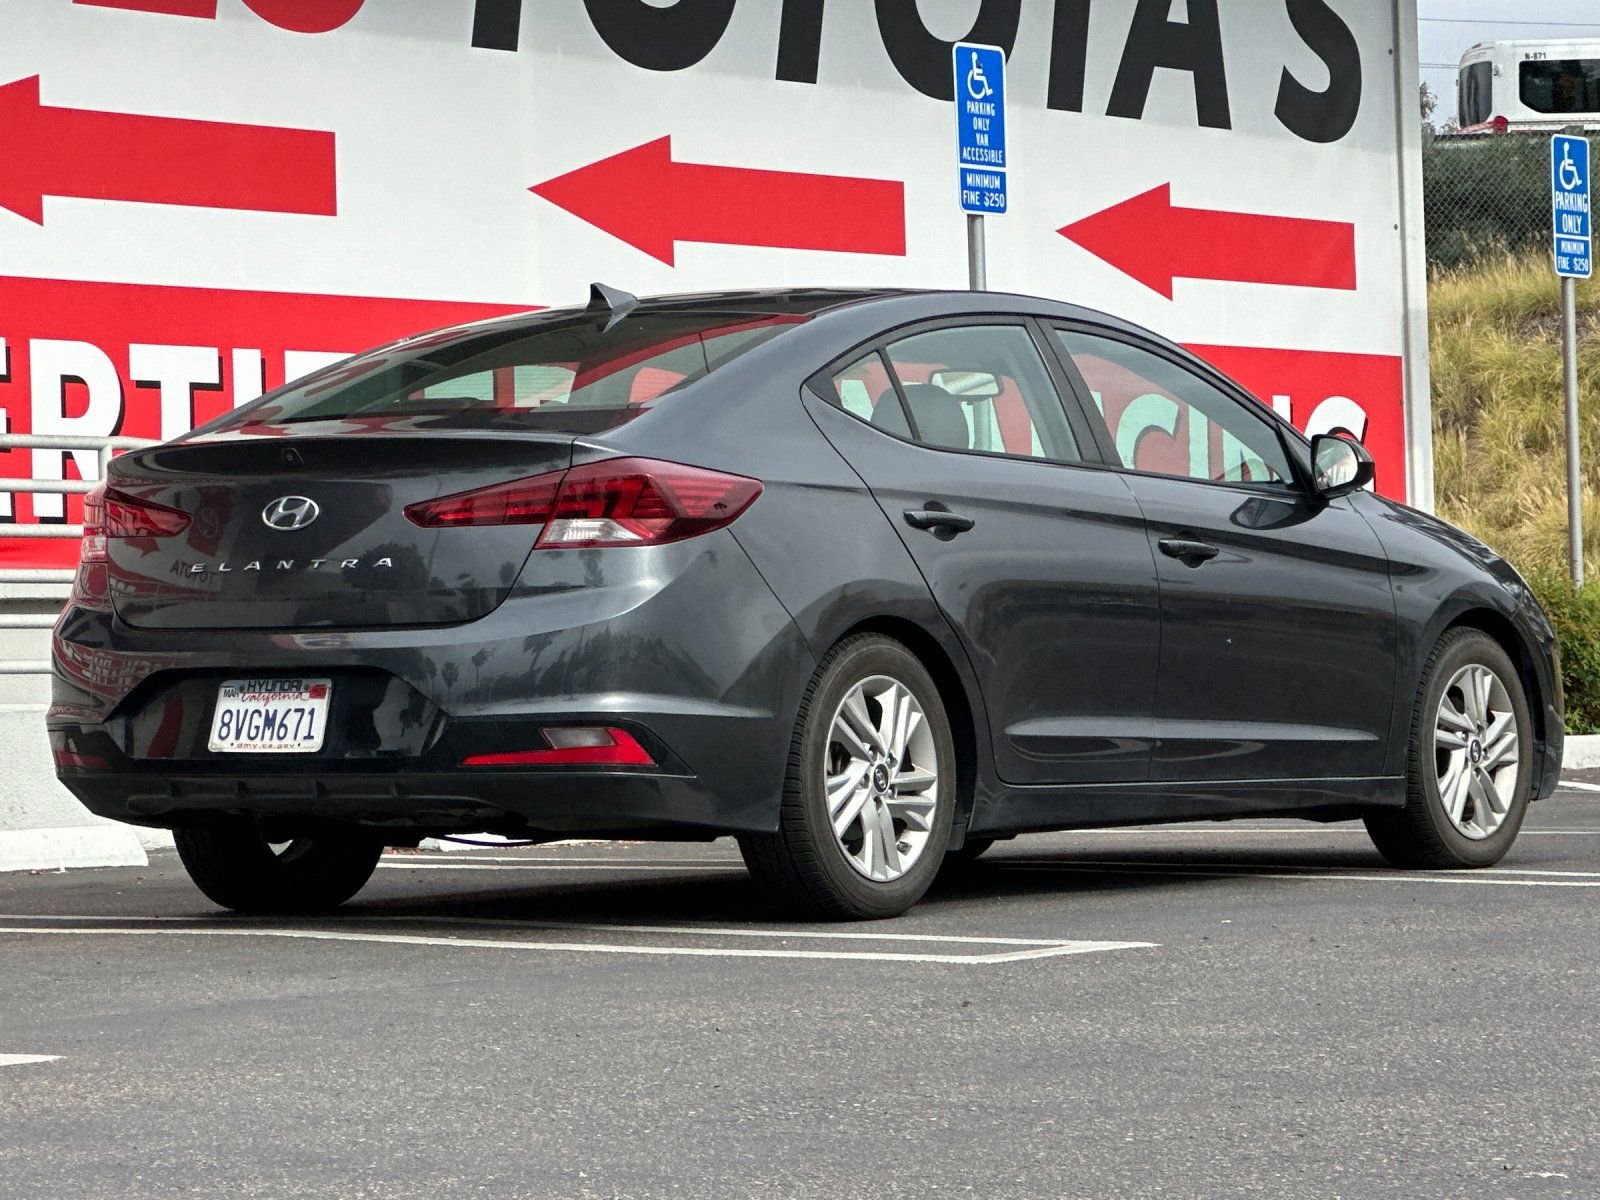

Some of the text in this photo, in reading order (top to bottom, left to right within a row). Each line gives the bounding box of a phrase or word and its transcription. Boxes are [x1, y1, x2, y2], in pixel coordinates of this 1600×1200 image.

[966, 101, 996, 117] PARKING
[973, 118, 990, 131] ONLY
[976, 133, 989, 147] VAN
[962, 147, 1003, 164] ACCESSIBLE
[966, 173, 1001, 190] MINIMUM
[963, 190, 1005, 208] FINE $250
[1555, 191, 1588, 213] PARKING
[1562, 214, 1582, 234] ONLY
[1560, 240, 1585, 255] MINIMUM
[1557, 256, 1589, 272] FINE $250
[190, 557, 393, 574] ELANTRA
[247, 679, 303, 692] HYUNDAI
[241, 691, 310, 707] California
[218, 707, 316, 741] 8VGM671
[236, 742, 295, 750] dmv.ca.gov
